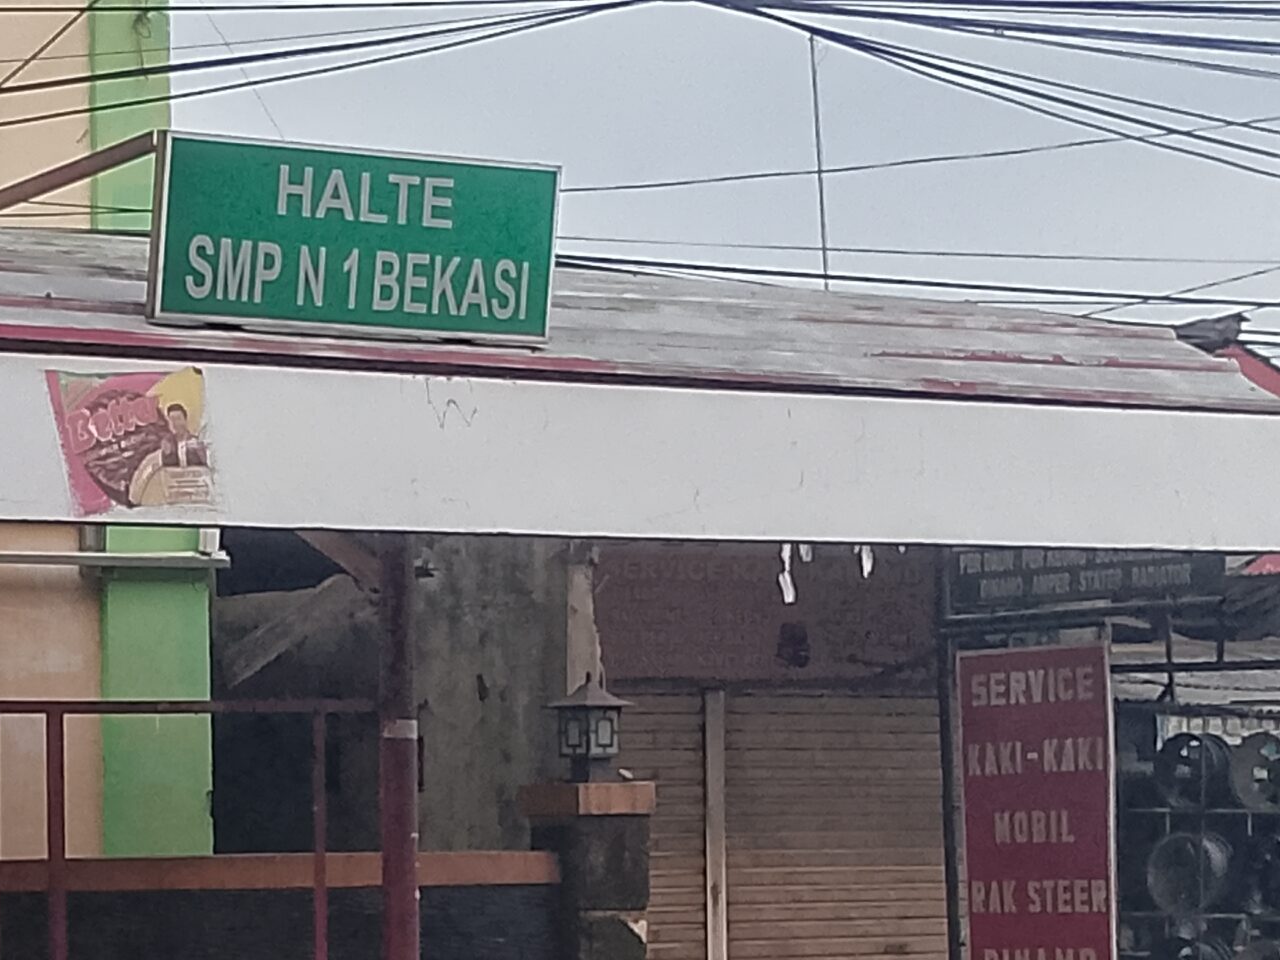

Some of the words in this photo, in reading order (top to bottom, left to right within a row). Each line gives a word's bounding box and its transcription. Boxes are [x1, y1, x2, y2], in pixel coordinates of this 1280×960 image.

[277, 164, 454, 229] HALTE
[185, 234, 282, 303] SMP
[297, 245, 326, 307] N
[343, 248, 359, 309] 1
[372, 250, 530, 320] BEKASI
[971, 664, 1094, 707] SERVICE
[968, 736, 1104, 776] KAKI-KAKI
[994, 809, 1075, 845] MOBIL
[971, 880, 1017, 914] RAK
[1027, 879, 1108, 914] STEER
